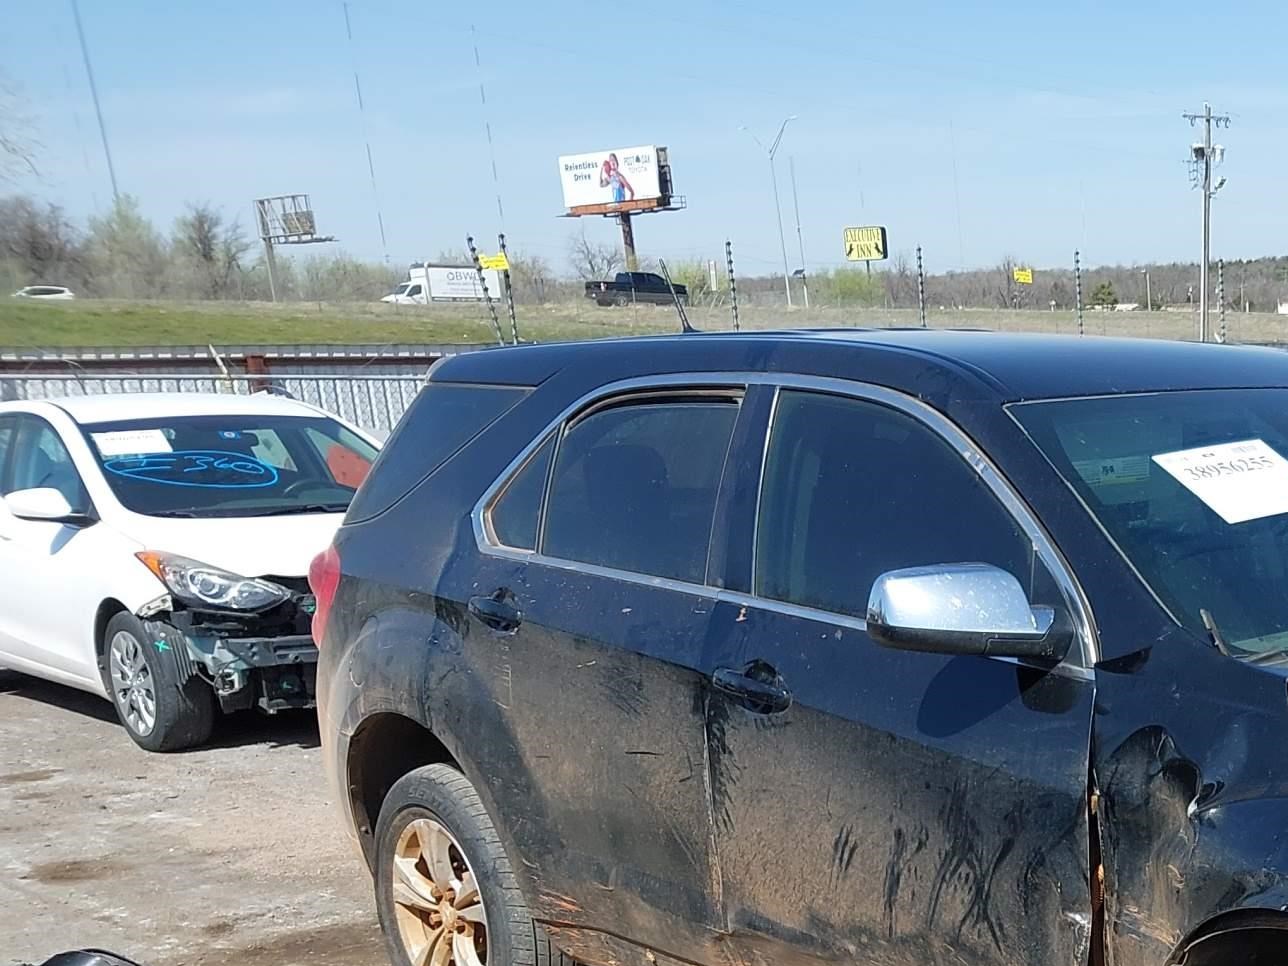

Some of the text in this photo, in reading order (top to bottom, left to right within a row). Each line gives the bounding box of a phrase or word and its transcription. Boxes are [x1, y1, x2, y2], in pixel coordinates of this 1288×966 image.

[564, 160, 599, 172] Relentless
[573, 173, 592, 182] Drive
[845, 228, 880, 243] EXECUTIVE
[856, 242, 873, 258] INN
[1183, 455, 1276, 481] 38956255
